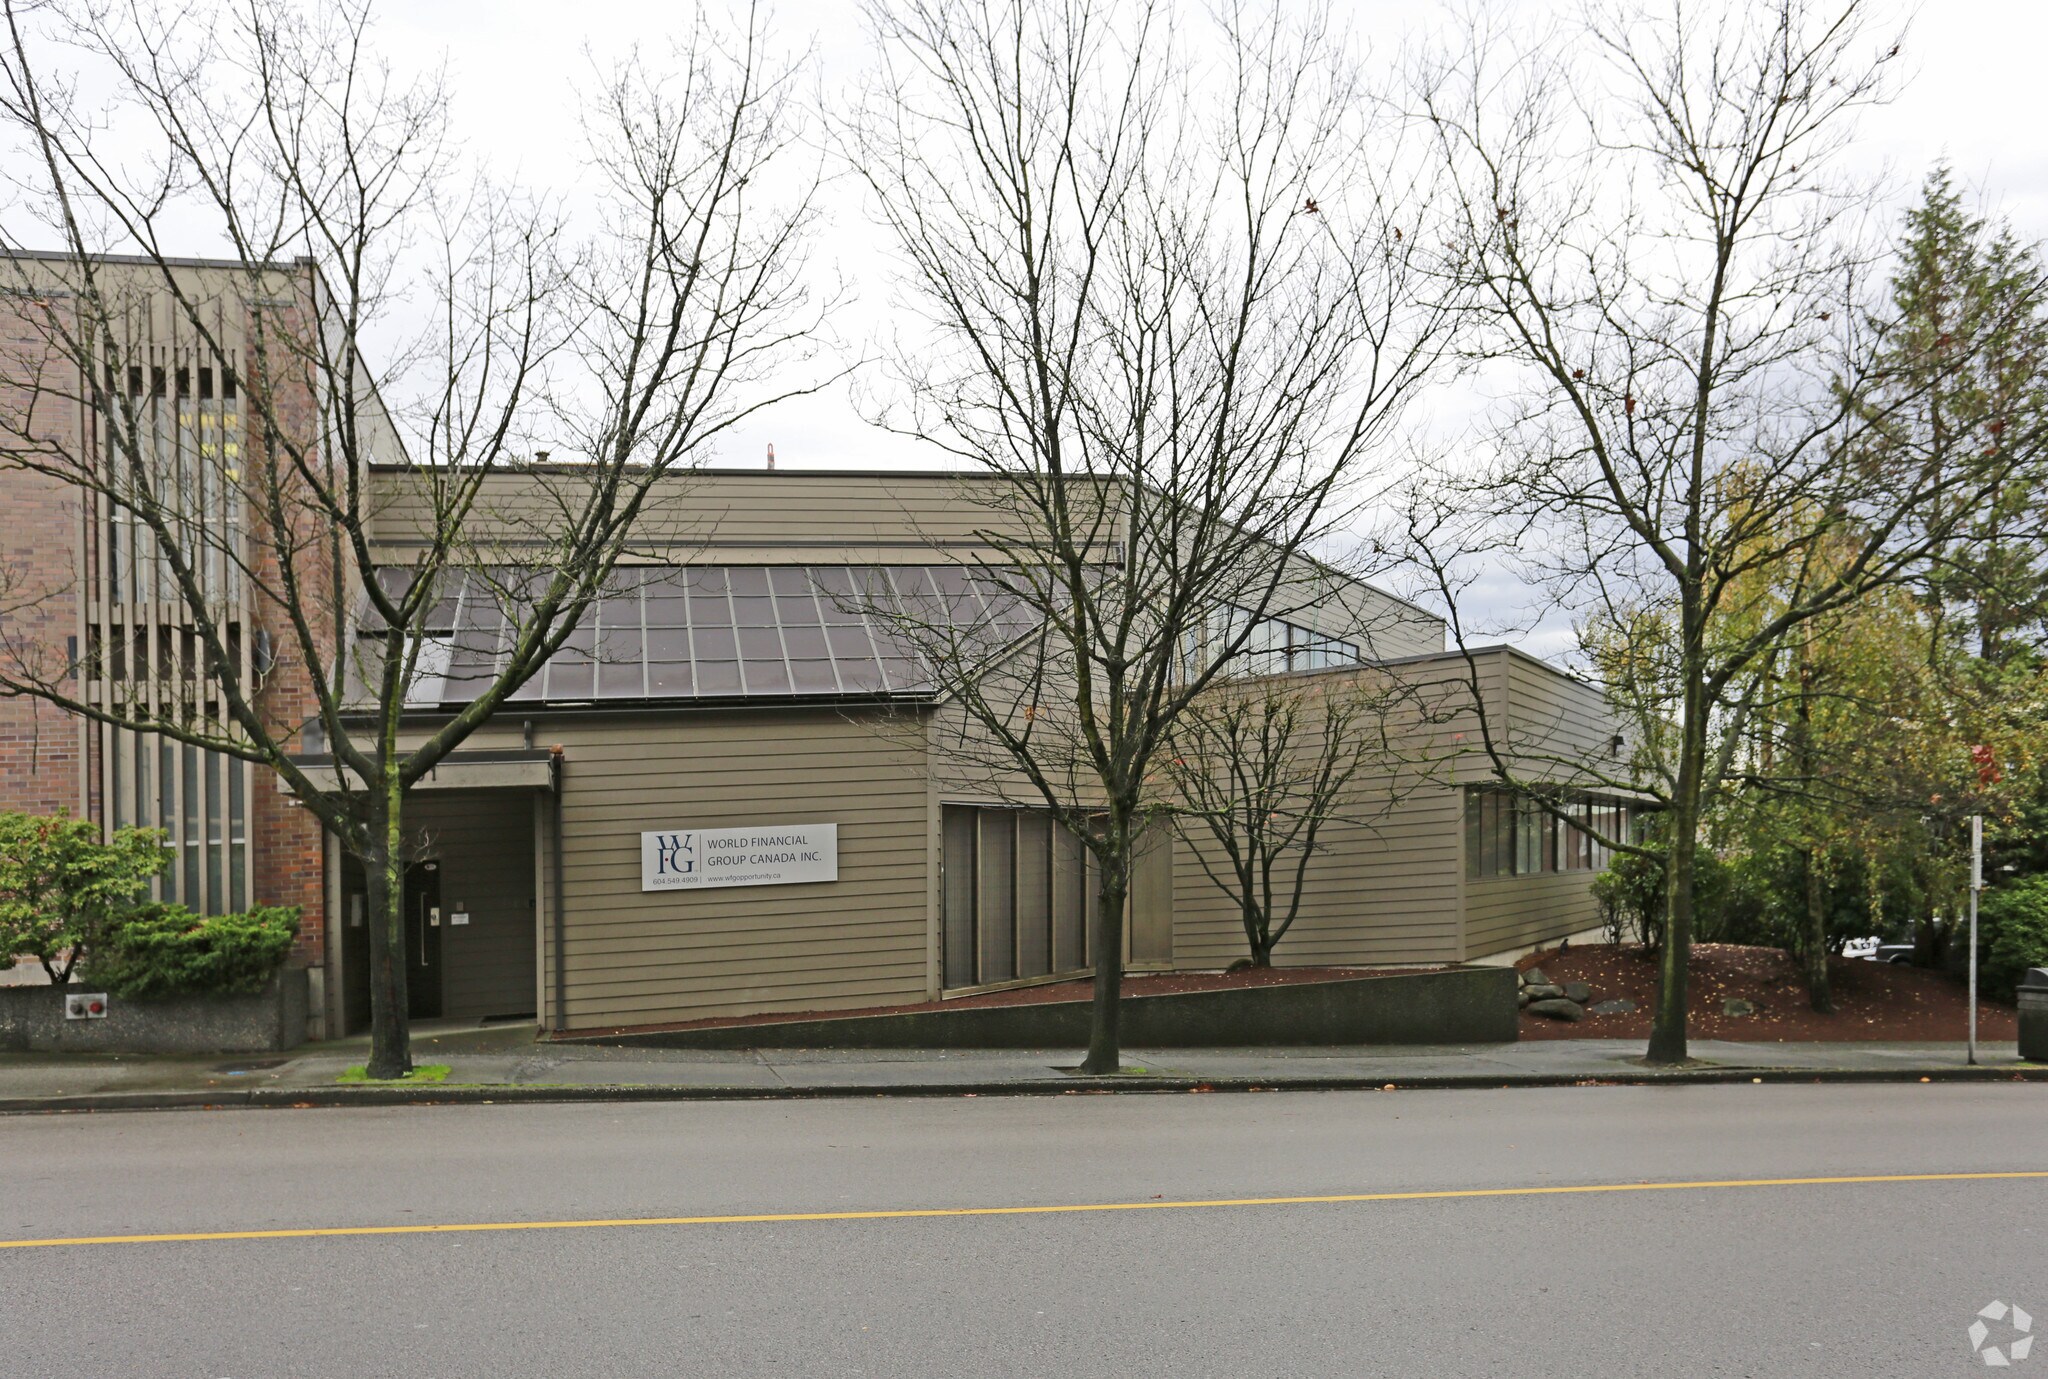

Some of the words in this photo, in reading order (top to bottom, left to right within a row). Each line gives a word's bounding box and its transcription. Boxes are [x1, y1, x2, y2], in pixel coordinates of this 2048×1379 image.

[707, 838, 748, 849] WORLD
[751, 835, 808, 847] FINANCIAL
[707, 855, 747, 867] GROUP
[749, 852, 797, 865] CANADA
[800, 851, 822, 862] INC.
[652, 876, 698, 885] 604.549.4909
[707, 873, 781, 883] www.wfgopportunity.ca
